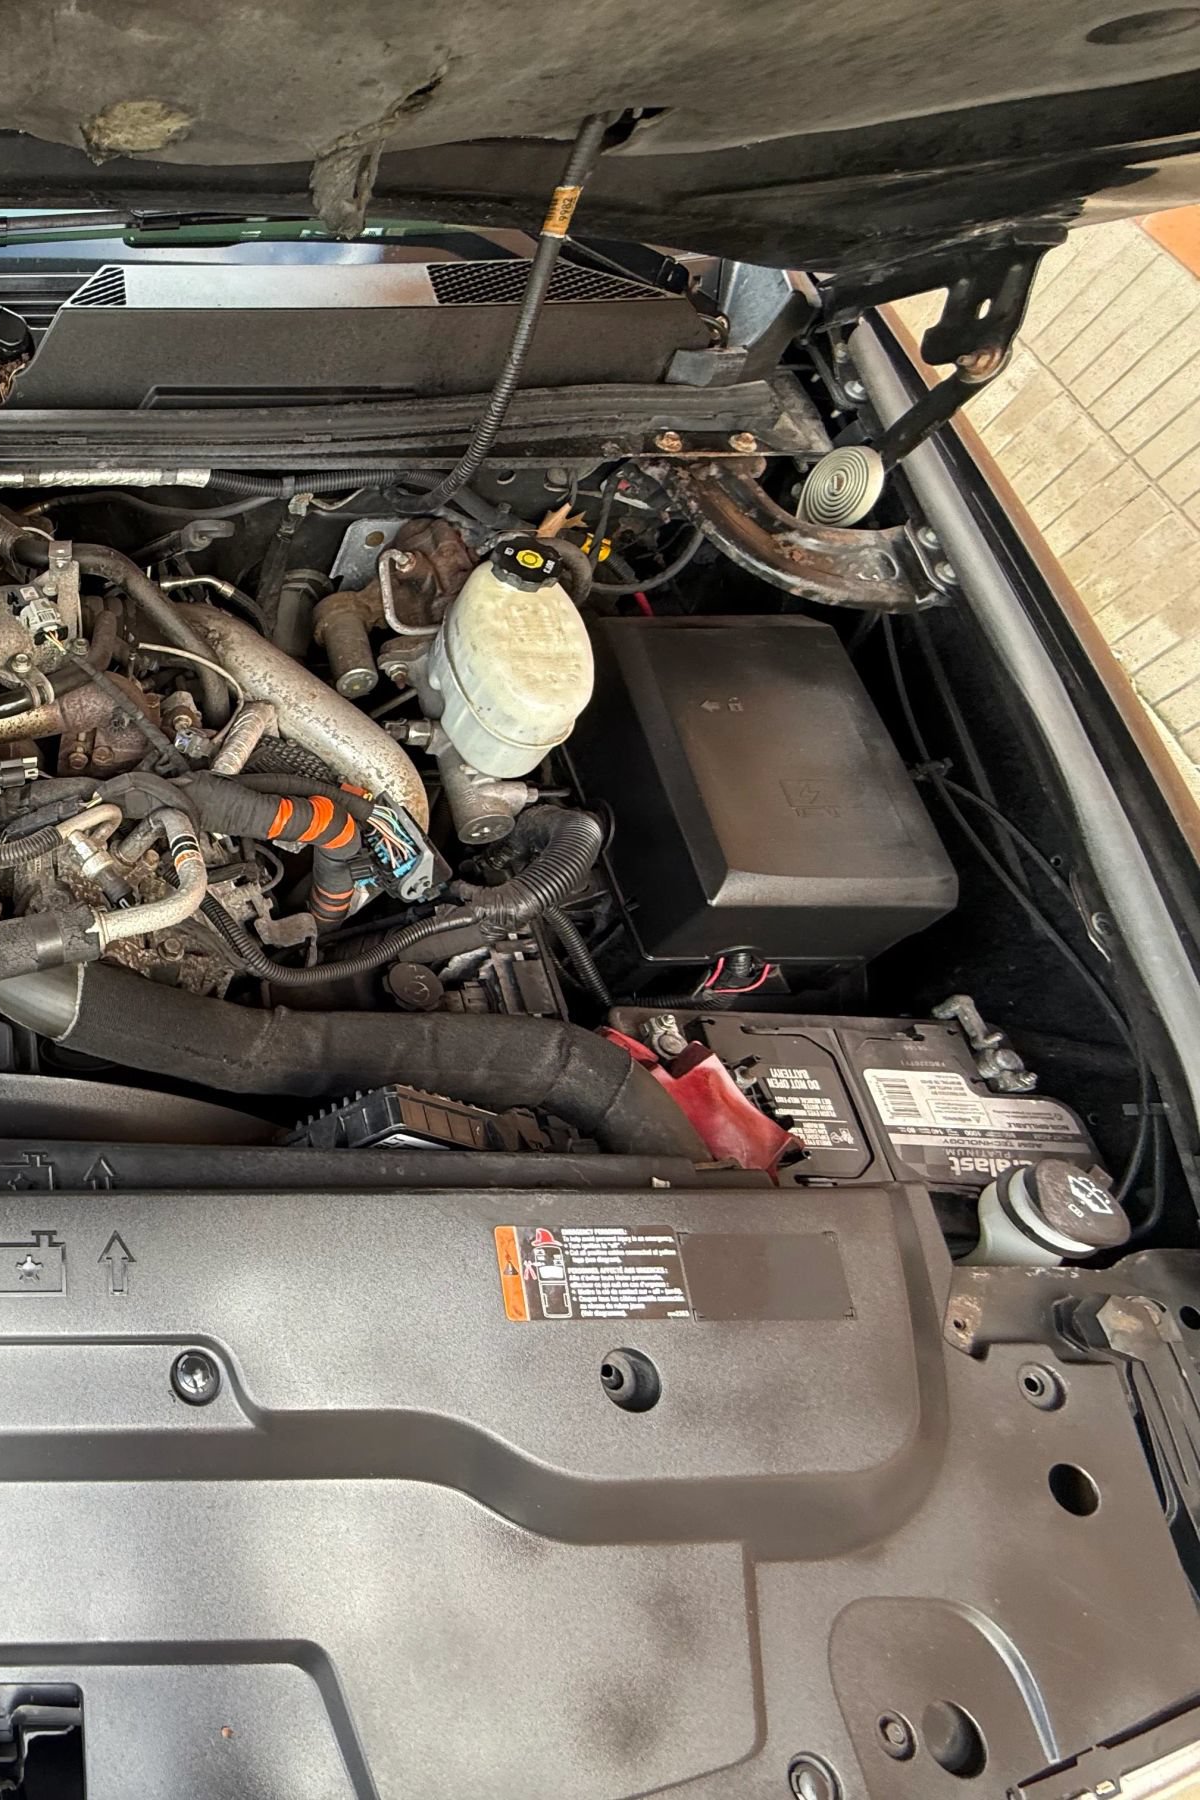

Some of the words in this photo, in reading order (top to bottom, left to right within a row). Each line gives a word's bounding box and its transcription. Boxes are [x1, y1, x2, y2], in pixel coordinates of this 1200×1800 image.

[559, 198, 572, 221] 9982
[769, 1068, 810, 1079] BATTERY!
[767, 1078, 789, 1089] OPEN
[790, 1079, 807, 1090] NOT
[807, 1080, 821, 1090] DO
[942, 1138, 1014, 1148] TECHNOLOGY
[945, 1148, 1011, 1158] PLATINUM
[949, 1156, 1033, 1178] alast
